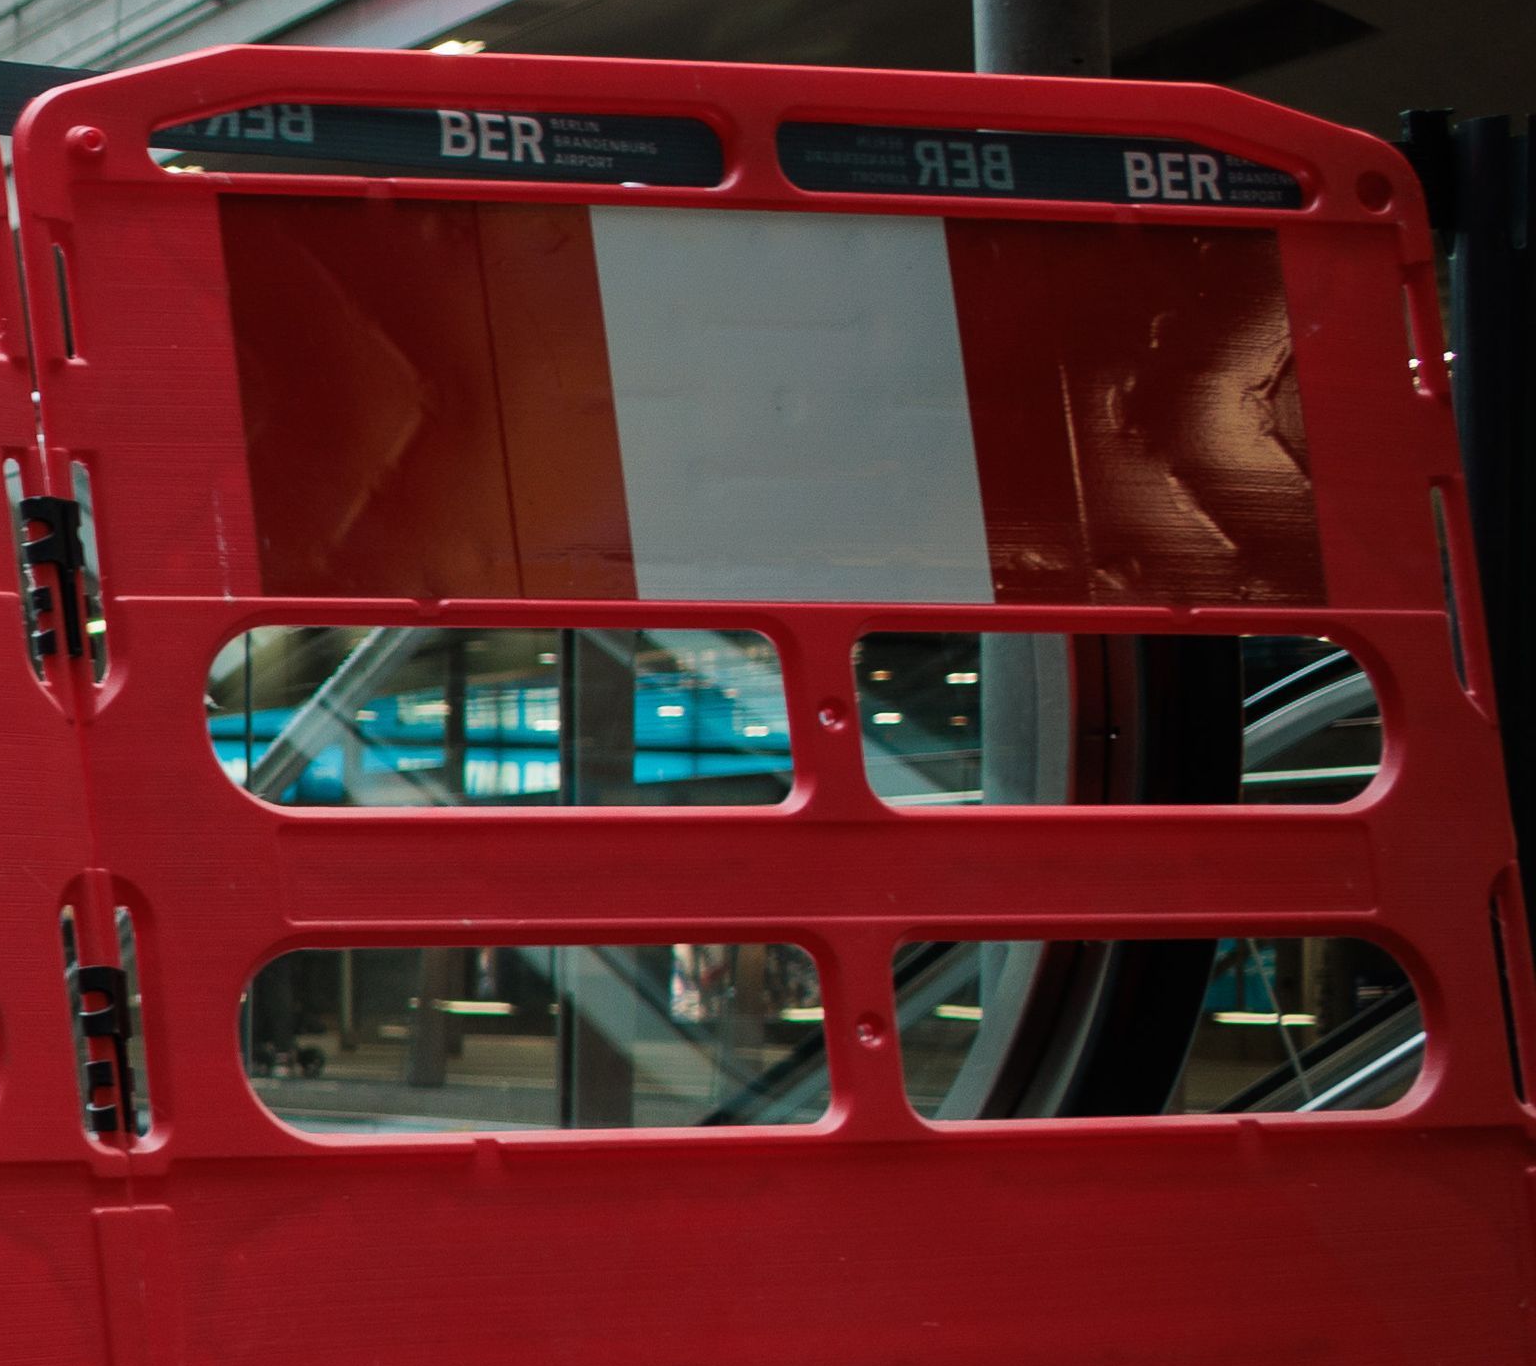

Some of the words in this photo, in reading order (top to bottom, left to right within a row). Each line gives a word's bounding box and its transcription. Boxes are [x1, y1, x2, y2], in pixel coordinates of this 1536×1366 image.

[436, 109, 546, 165] BER
[554, 154, 613, 169] AIRPORT
[1123, 151, 1223, 201] BER
